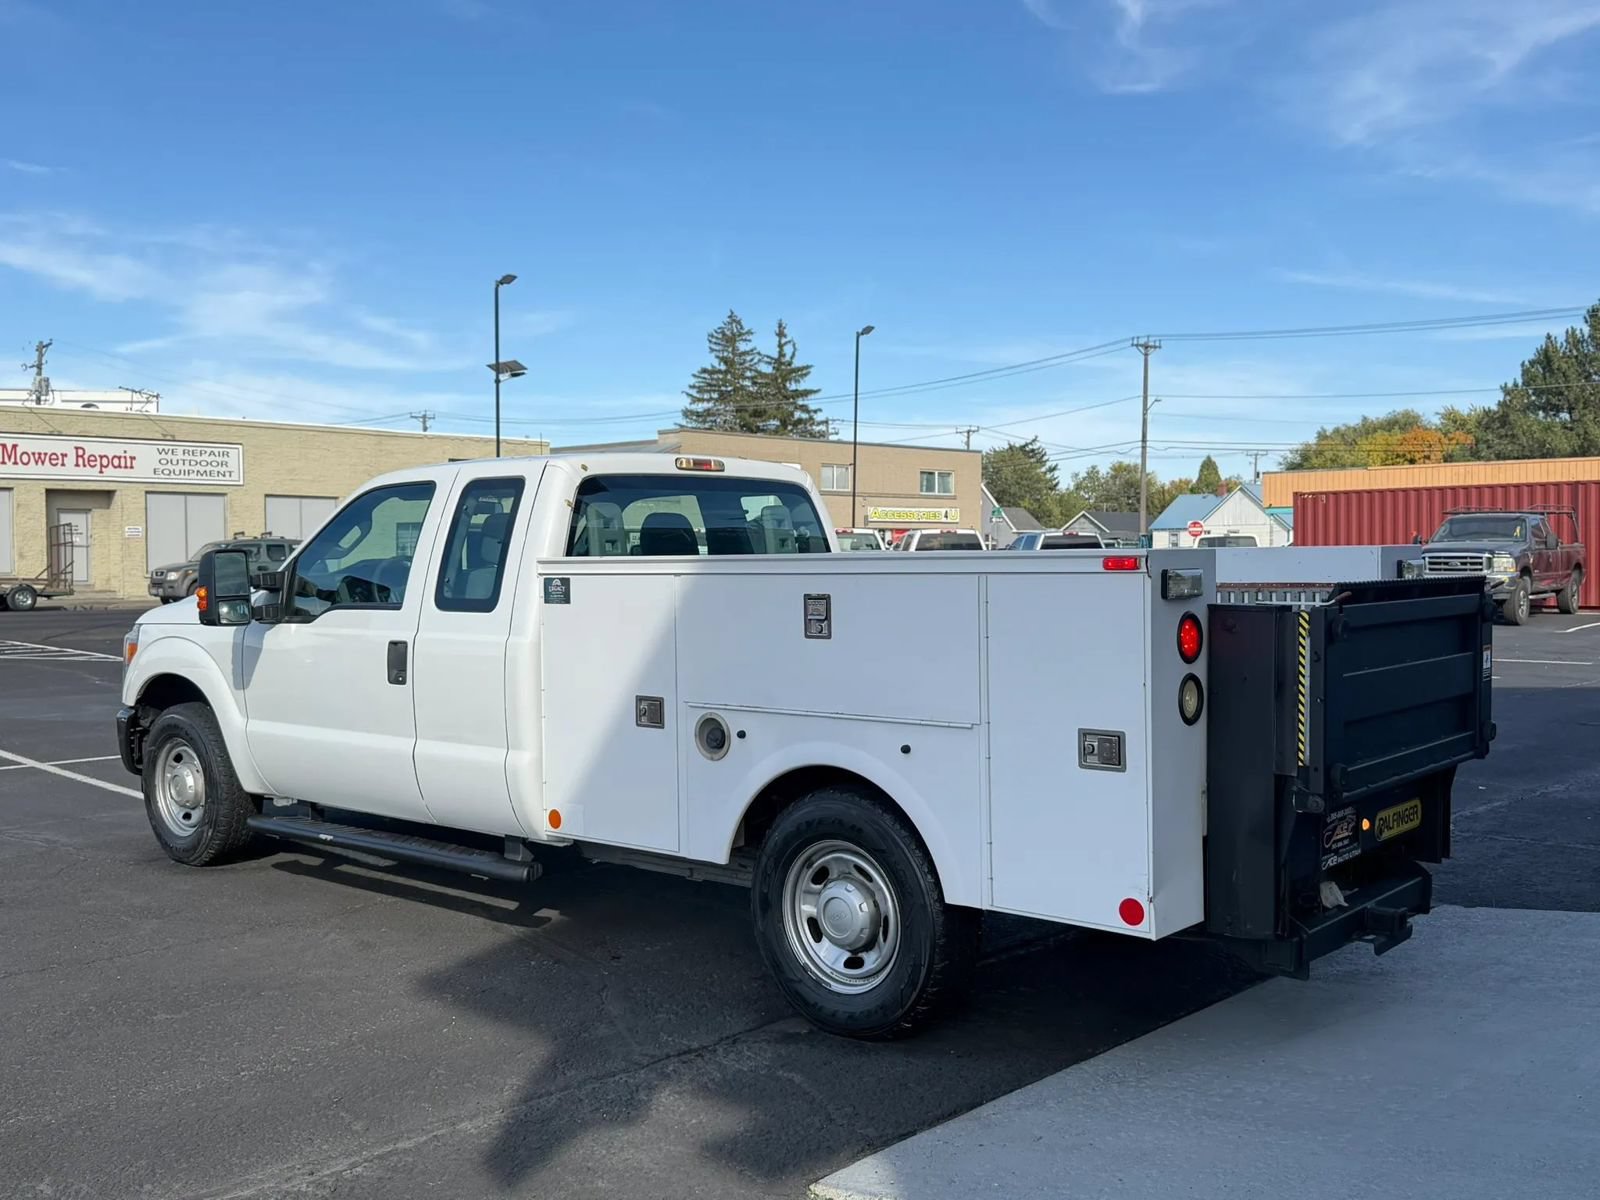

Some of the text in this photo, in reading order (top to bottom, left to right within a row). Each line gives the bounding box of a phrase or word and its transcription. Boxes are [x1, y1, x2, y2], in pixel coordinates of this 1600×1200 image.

[0, 443, 136, 474] Mower Repair
[157, 447, 230, 459] WE REPAIR
[158, 457, 229, 468] OUTDOOR
[153, 467, 235, 478] EQUIPMENT
[943, 509, 949, 520] 4
[949, 508, 958, 520] U
[1377, 804, 1419, 834] PALFINGER
